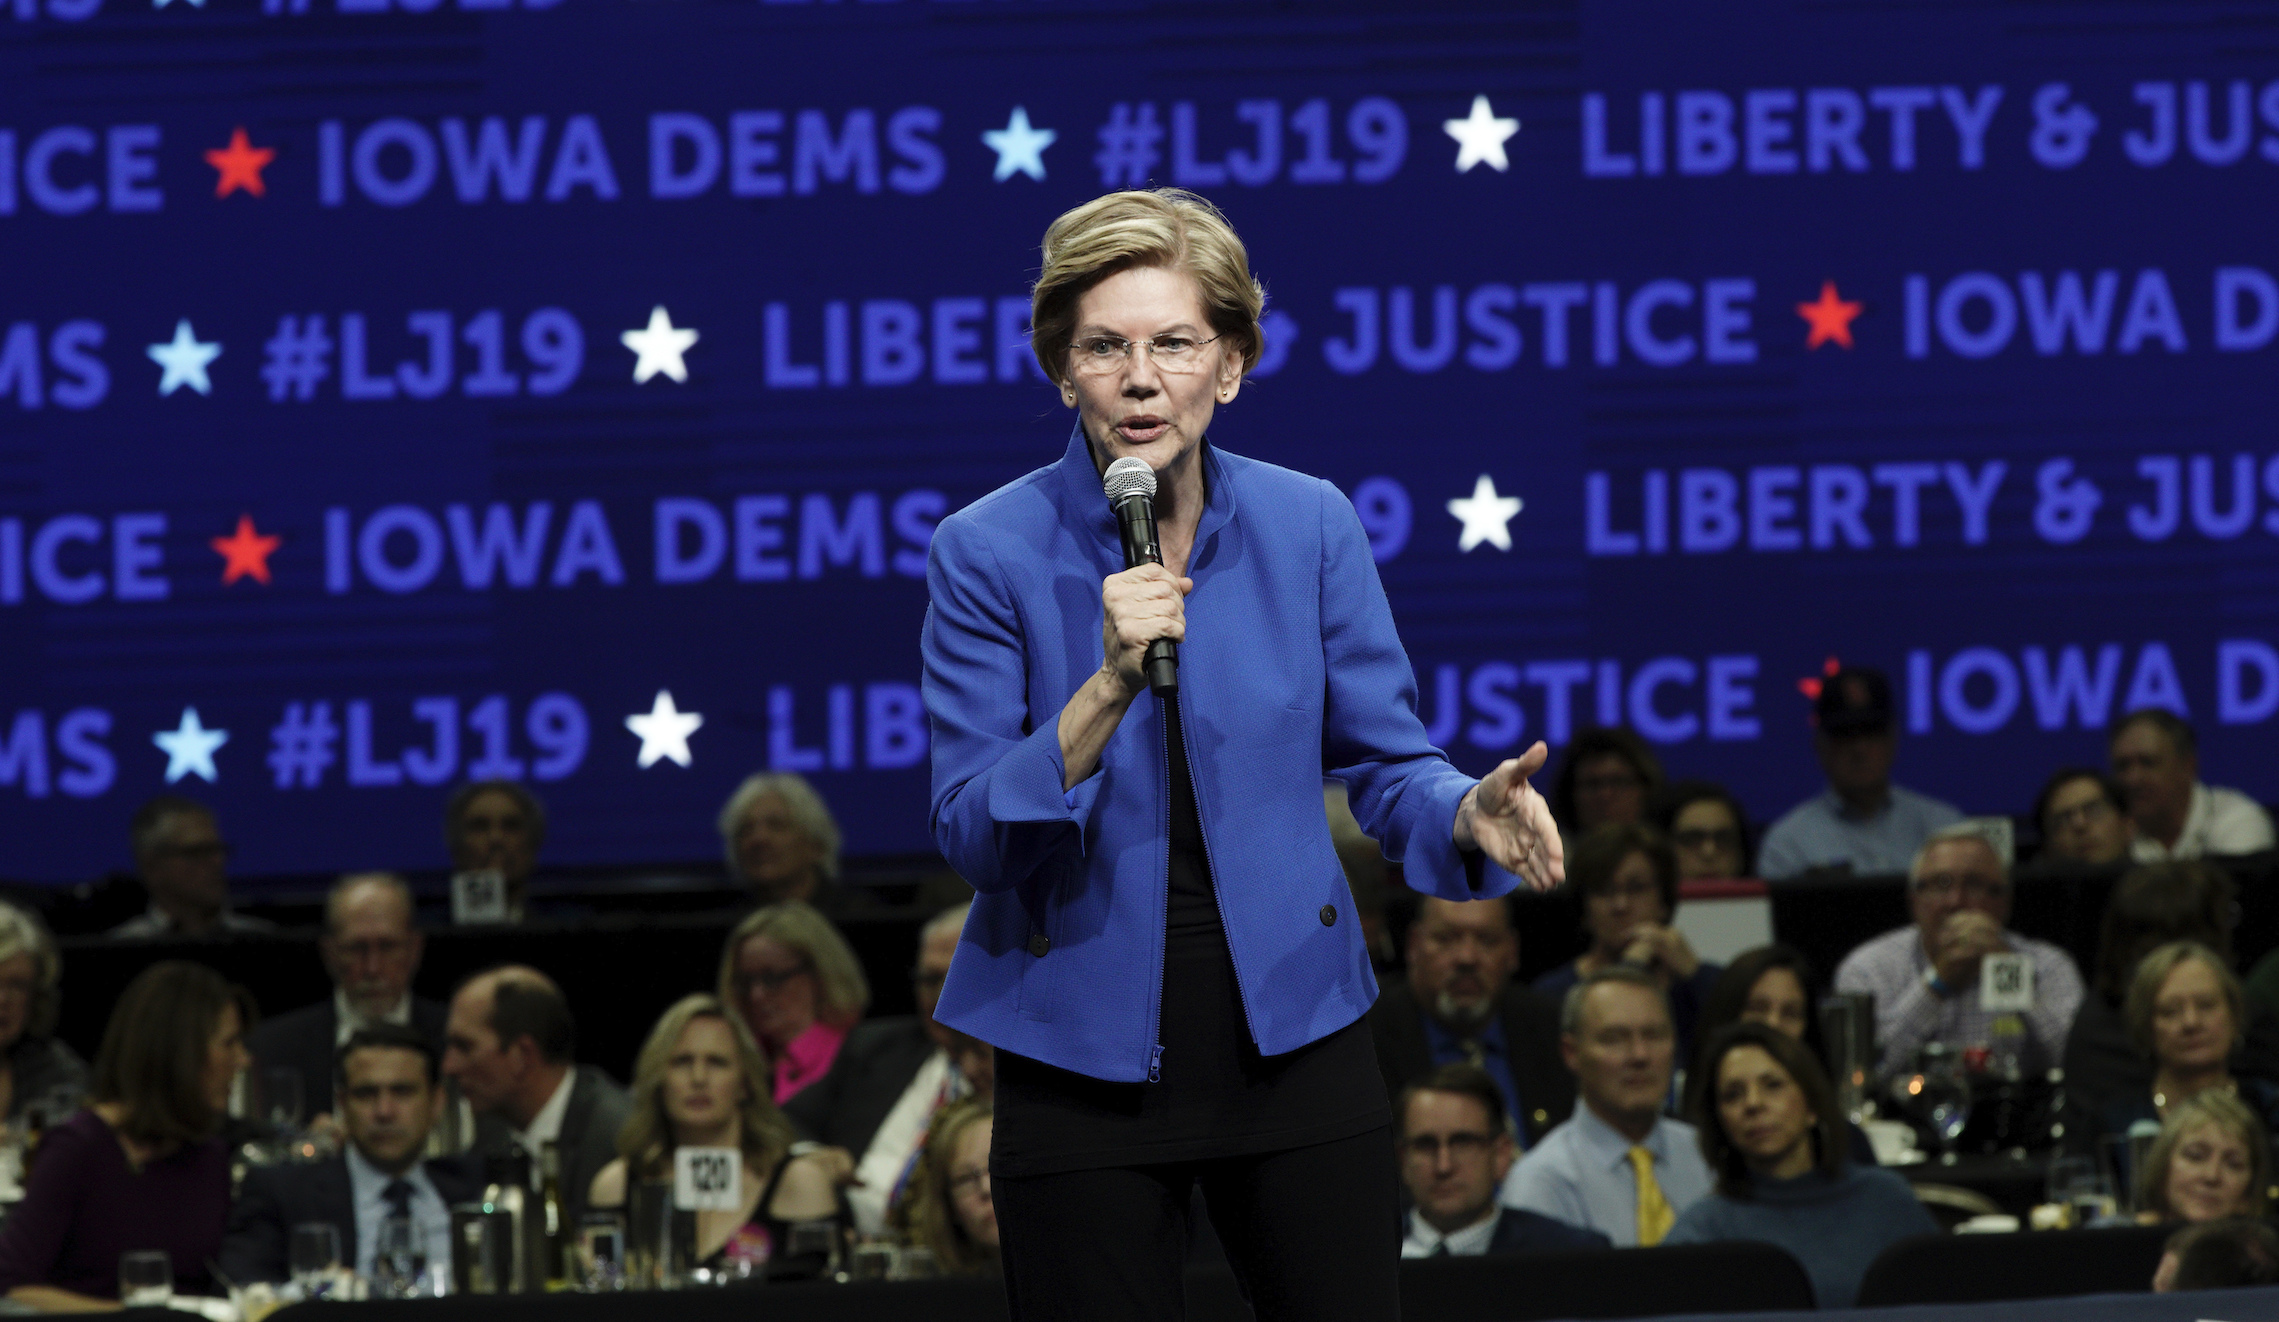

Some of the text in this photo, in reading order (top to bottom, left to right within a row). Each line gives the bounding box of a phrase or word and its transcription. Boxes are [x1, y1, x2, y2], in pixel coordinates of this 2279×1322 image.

[0, 125, 165, 217] ICE
[318, 113, 621, 207] IOWA
[647, 106, 947, 200] DEMS
[1093, 96, 1409, 189] #LJ19
[1581, 85, 2005, 178] LIBERTY
[2029, 82, 2100, 169] &
[259, 306, 586, 403] #LJ19
[762, 295, 1052, 389] LIBER
[1322, 277, 1759, 375] JUSTICE
[1903, 268, 2189, 360] IOWA
[0, 512, 171, 605] ICE
[324, 499, 625, 595] IOWA
[654, 490, 946, 584] DEMS
[1584, 459, 2009, 556] LIBERTY
[2032, 457, 2103, 544] &
[266, 692, 591, 789] #LJ19
[1906, 642, 2188, 735] IOWA
